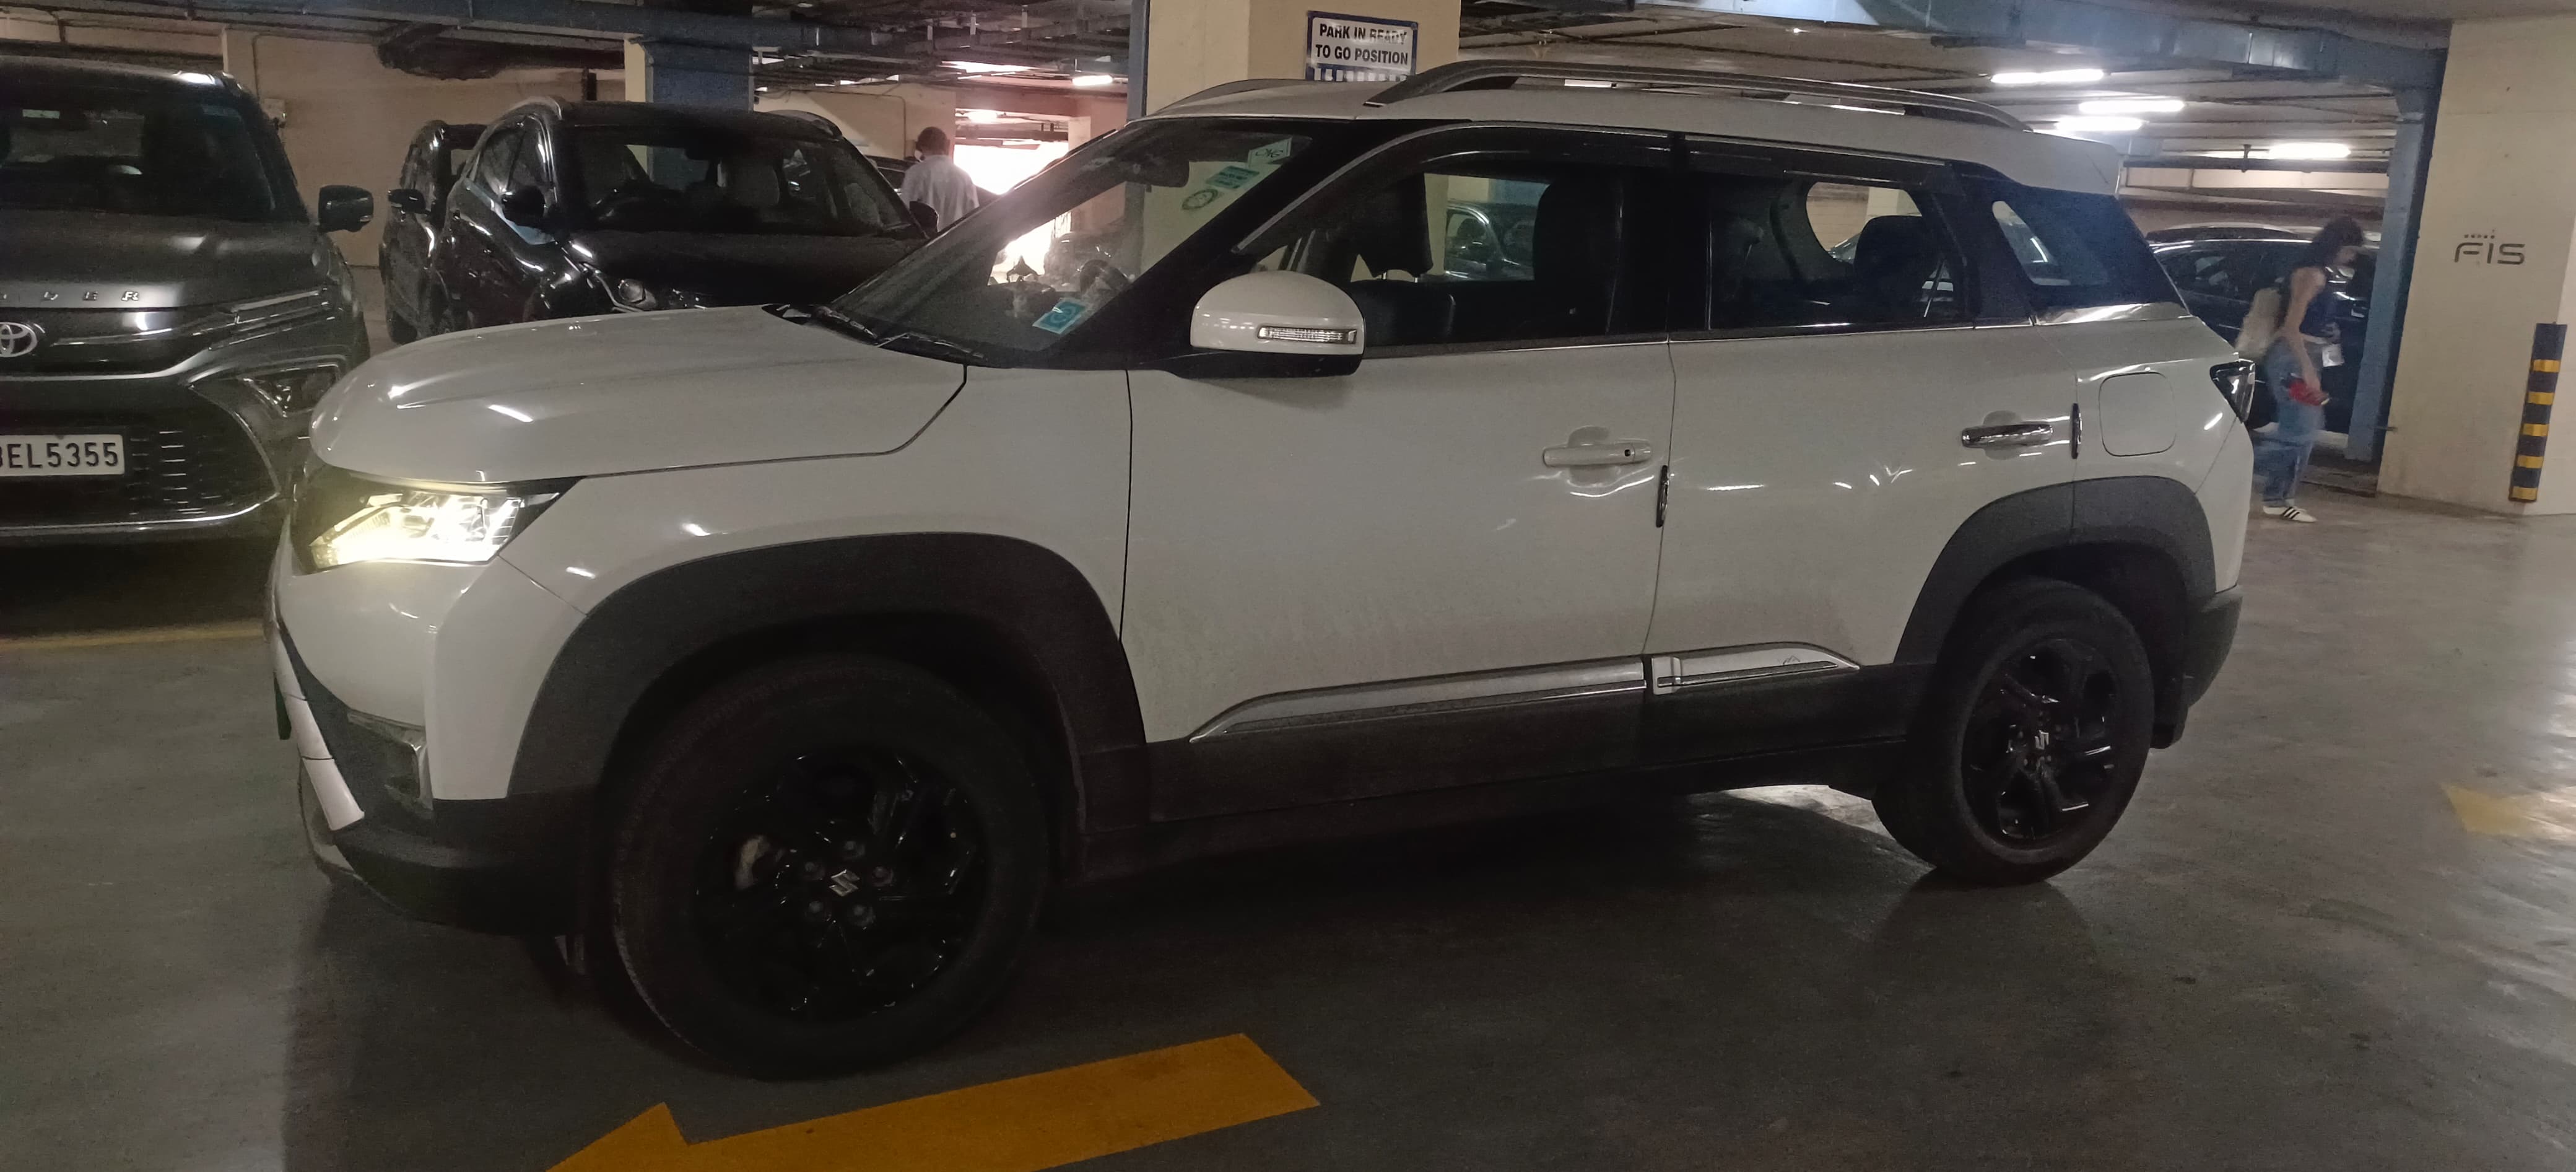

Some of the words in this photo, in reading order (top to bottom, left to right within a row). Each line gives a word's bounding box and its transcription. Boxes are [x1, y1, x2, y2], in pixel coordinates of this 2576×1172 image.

[1320, 24, 1350, 39] PARK
[1354, 27, 1365, 40] IN
[1315, 44, 1331, 58] TO
[1334, 46, 1351, 60] GO
[1355, 48, 1408, 65] POSITION
